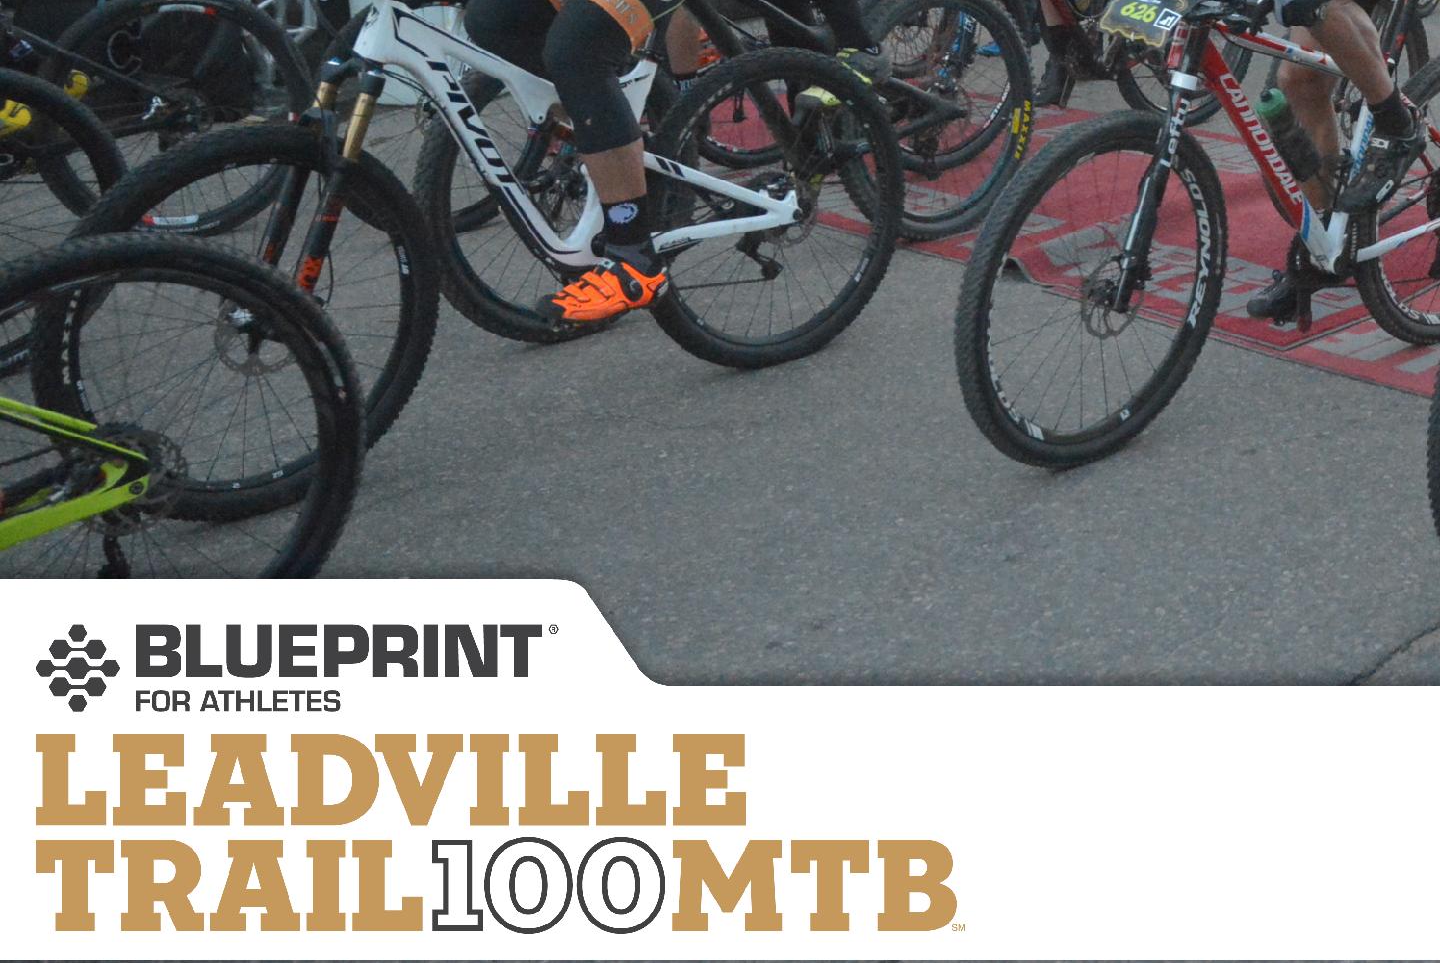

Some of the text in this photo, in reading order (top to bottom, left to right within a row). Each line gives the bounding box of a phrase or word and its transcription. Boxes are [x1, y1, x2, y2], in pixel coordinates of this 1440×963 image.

[1120, 1, 1156, 23] 626
[426, 59, 517, 185] PIVOT
[1013, 99, 1032, 160] MAXXIS
[1180, 168, 1214, 329] REYNOLDS
